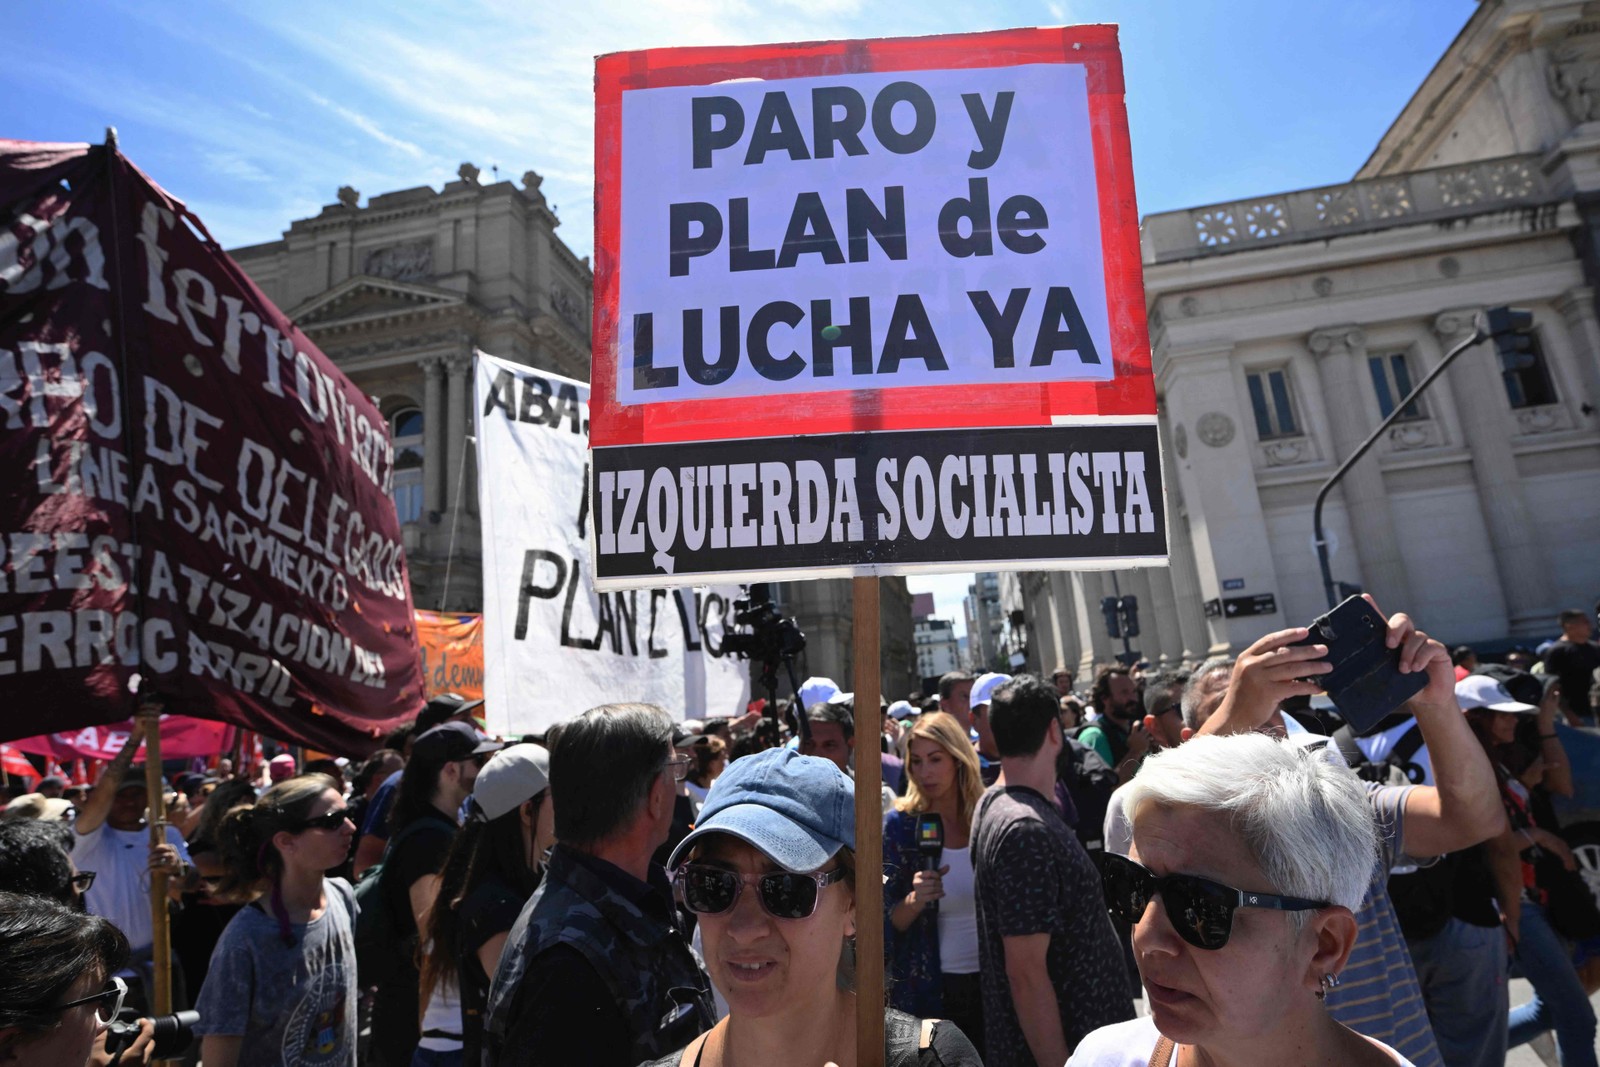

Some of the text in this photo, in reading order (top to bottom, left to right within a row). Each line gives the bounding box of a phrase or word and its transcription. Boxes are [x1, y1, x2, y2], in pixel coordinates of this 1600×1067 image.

[691, 81, 1015, 170] PARO y
[669, 177, 1049, 277] PLAN de
[632, 286, 1102, 391] LUCHA YA
[144, 375, 224, 494] DE
[484, 369, 589, 437] ABA
[36, 438, 349, 611] LINEA SARMIENTO
[599, 458, 865, 574] IZQUIERDA
[875, 451, 1155, 541] SOCIALISTA
[0, 531, 352, 676] EESTATIZACION
[515, 549, 638, 656] PLAN
